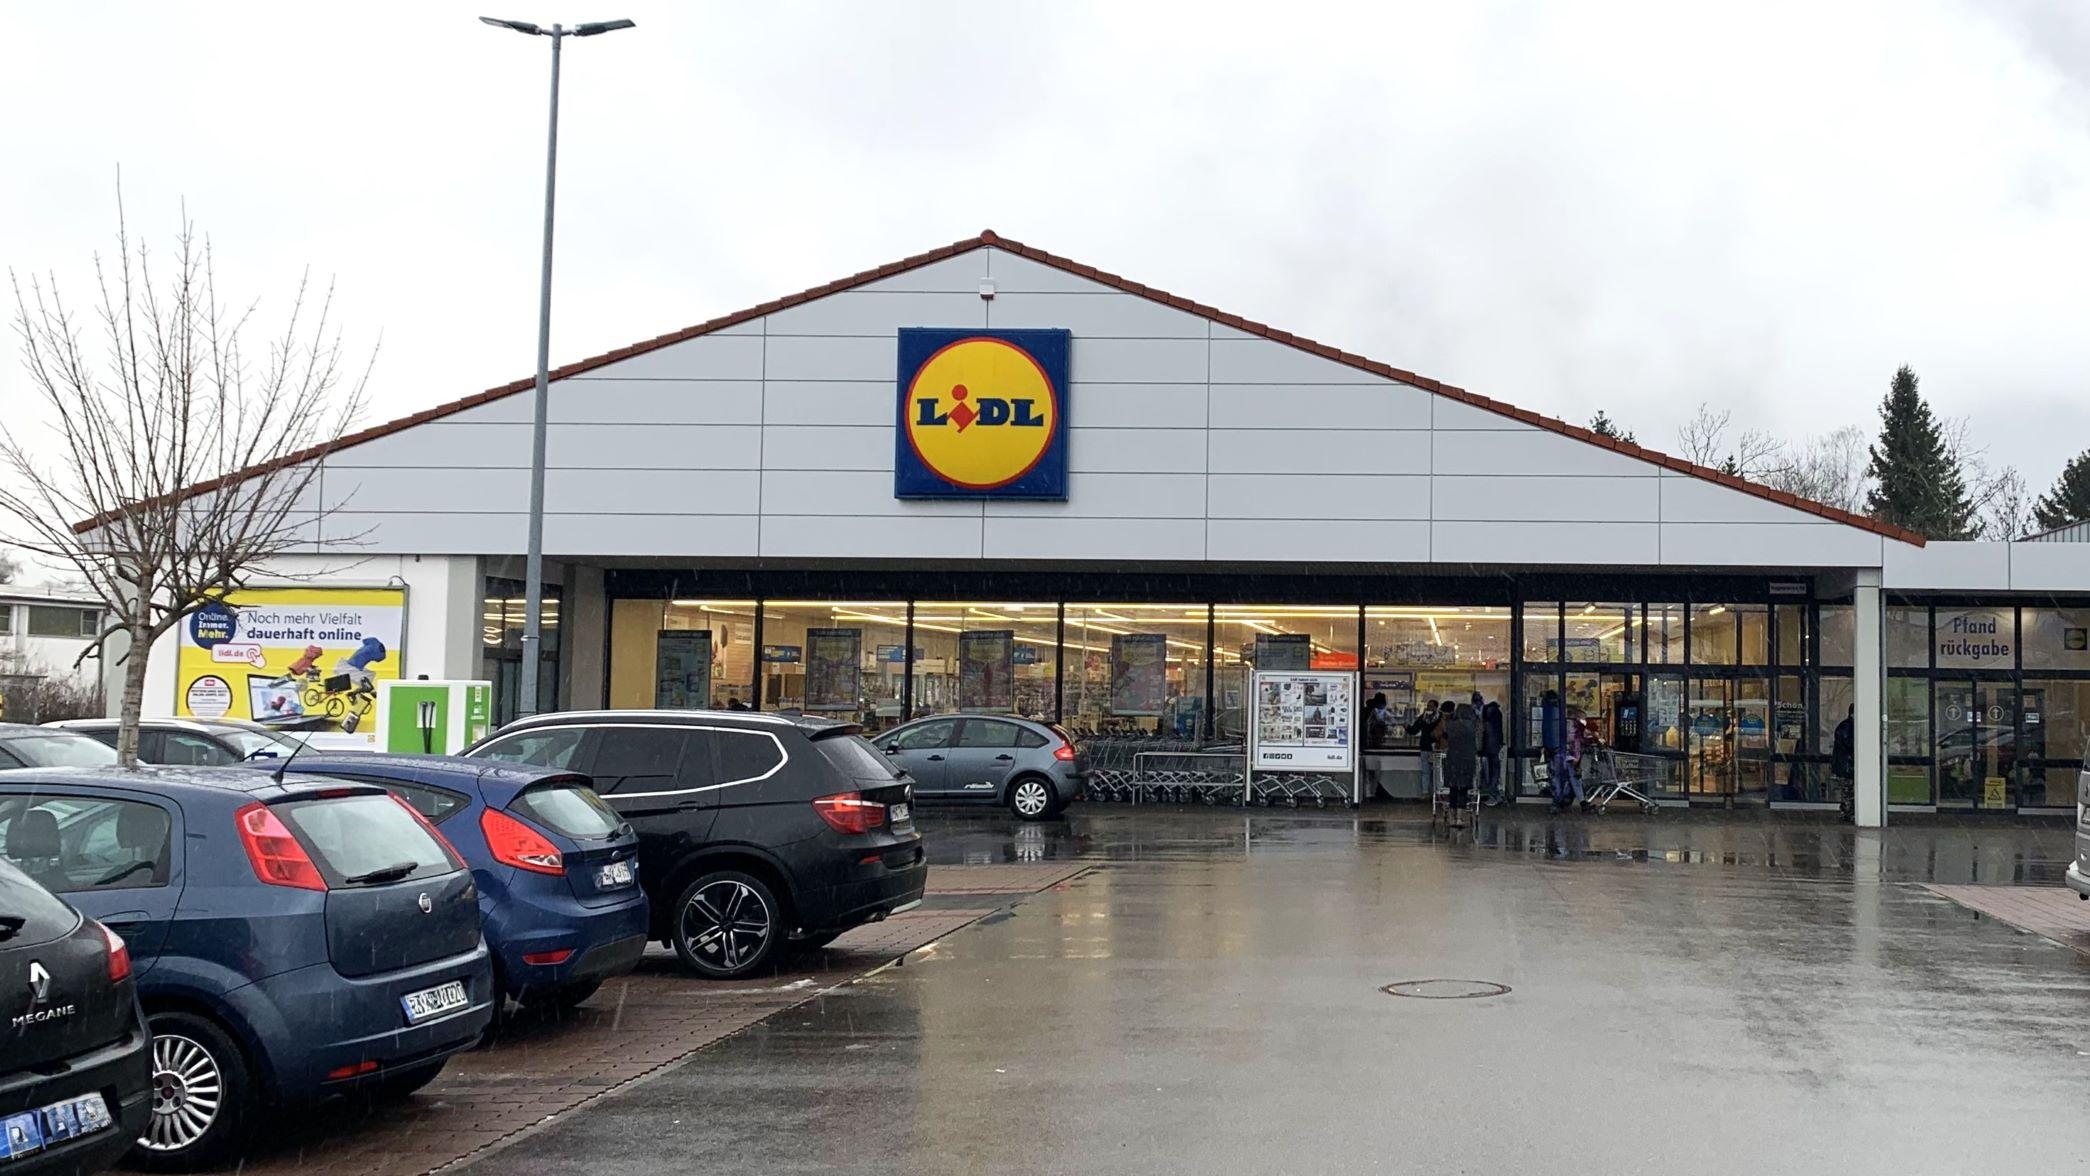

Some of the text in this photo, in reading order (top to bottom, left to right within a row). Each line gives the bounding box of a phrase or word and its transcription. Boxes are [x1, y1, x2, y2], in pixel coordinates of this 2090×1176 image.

[247, 612, 362, 625] Noch mehr Vielfalt
[1953, 617, 1996, 633] Pfand
[197, 629, 228, 638] Mehr.
[247, 627, 362, 640] dauerhaft online
[1940, 639, 2009, 659] rückgabe
[12, 1004, 76, 1027] MEGANE
